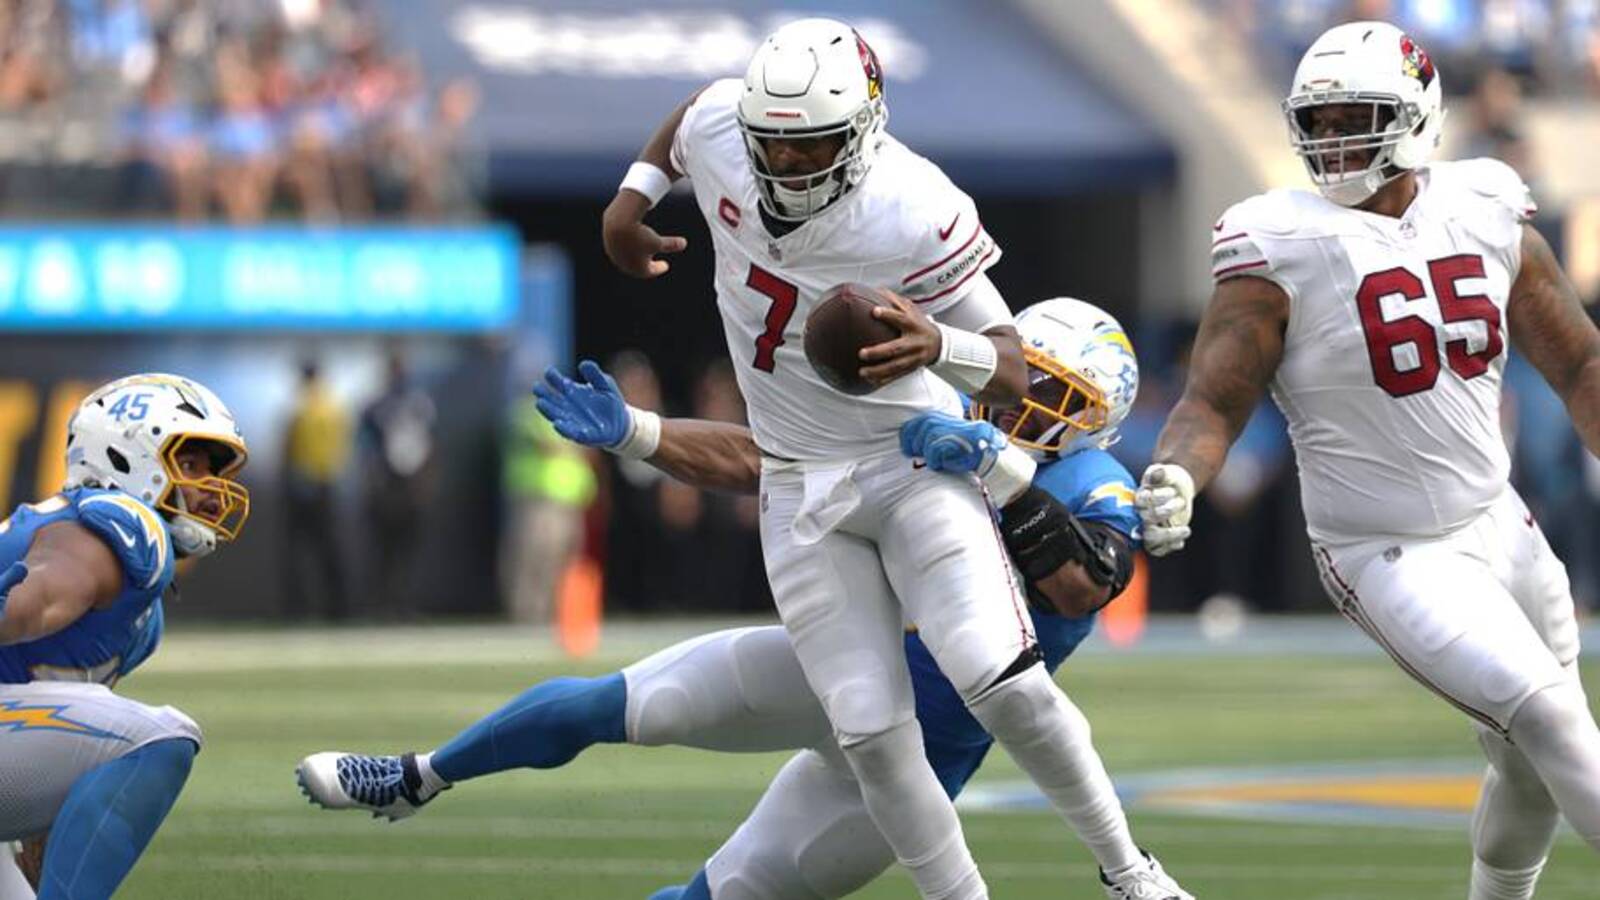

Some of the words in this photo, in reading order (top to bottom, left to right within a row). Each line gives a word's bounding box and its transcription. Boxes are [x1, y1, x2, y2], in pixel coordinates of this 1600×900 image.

[719, 197, 741, 228] C
[746, 262, 799, 373] 7
[1355, 253, 1504, 398] 65
[107, 393, 155, 422] 45
